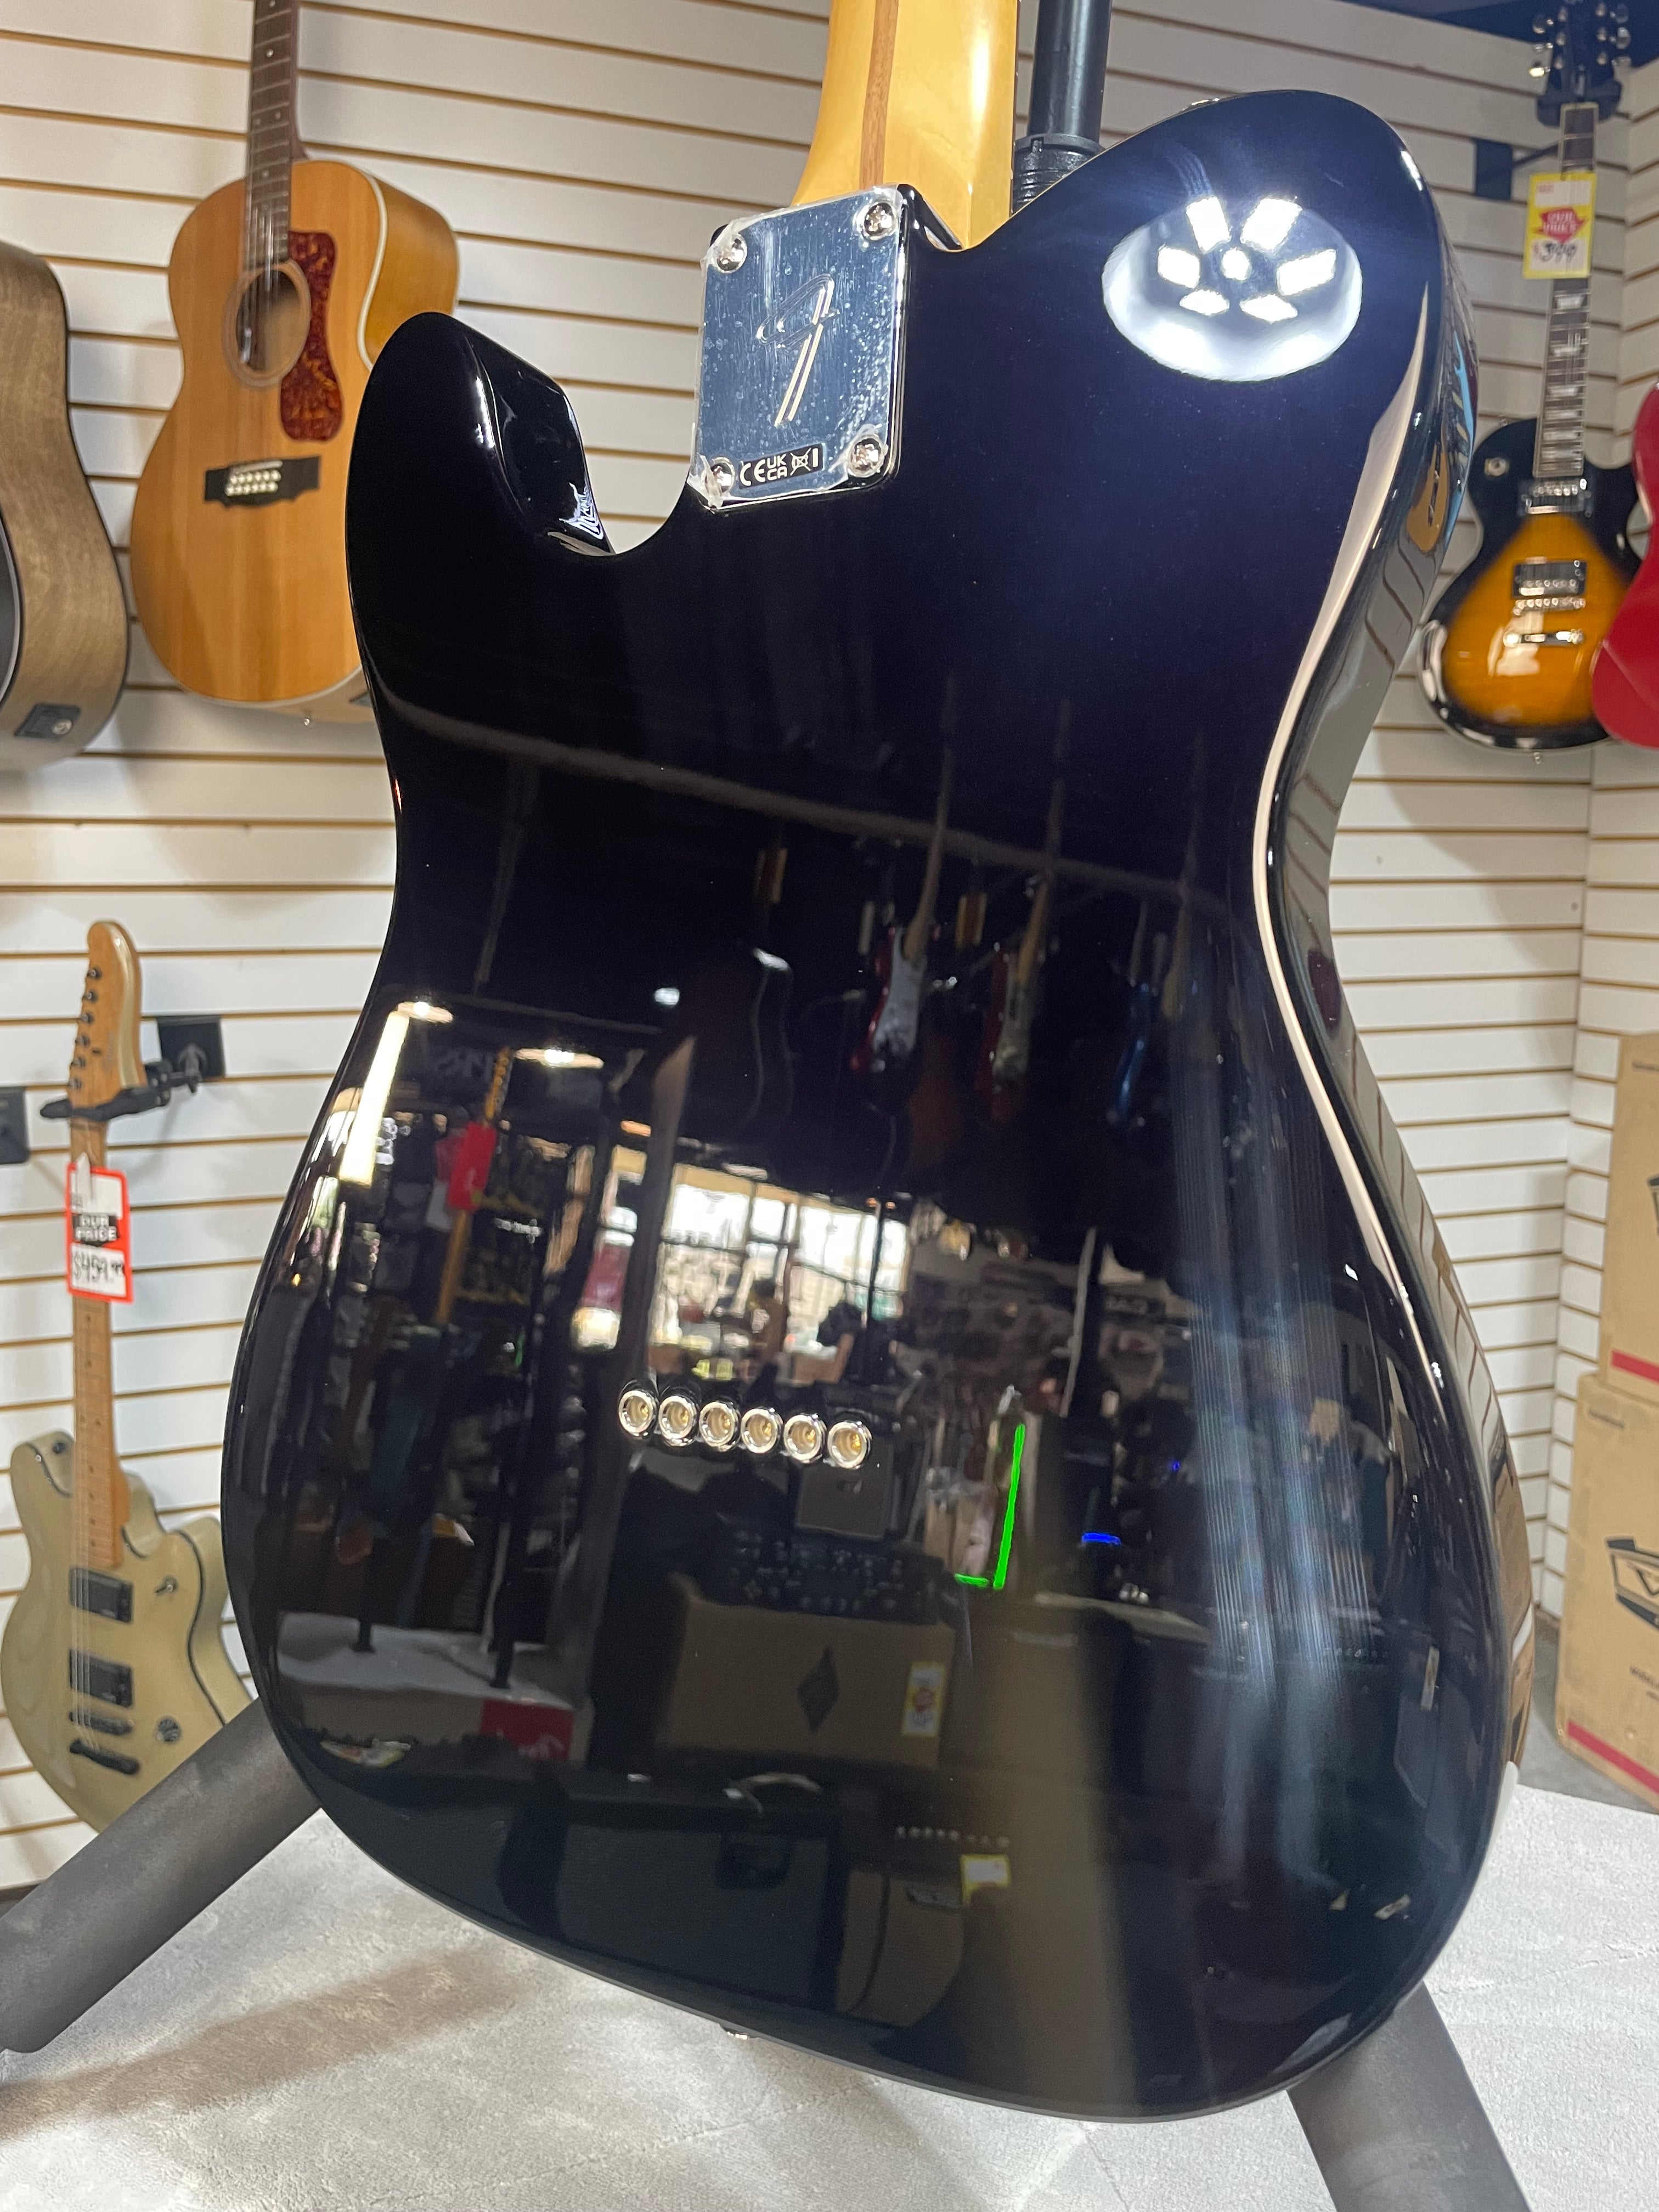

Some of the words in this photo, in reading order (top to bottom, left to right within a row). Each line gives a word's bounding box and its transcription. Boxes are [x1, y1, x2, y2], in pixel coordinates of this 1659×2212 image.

[740, 459, 765, 486] CE
[767, 454, 786, 467] UK
[767, 466, 787, 481] CA
